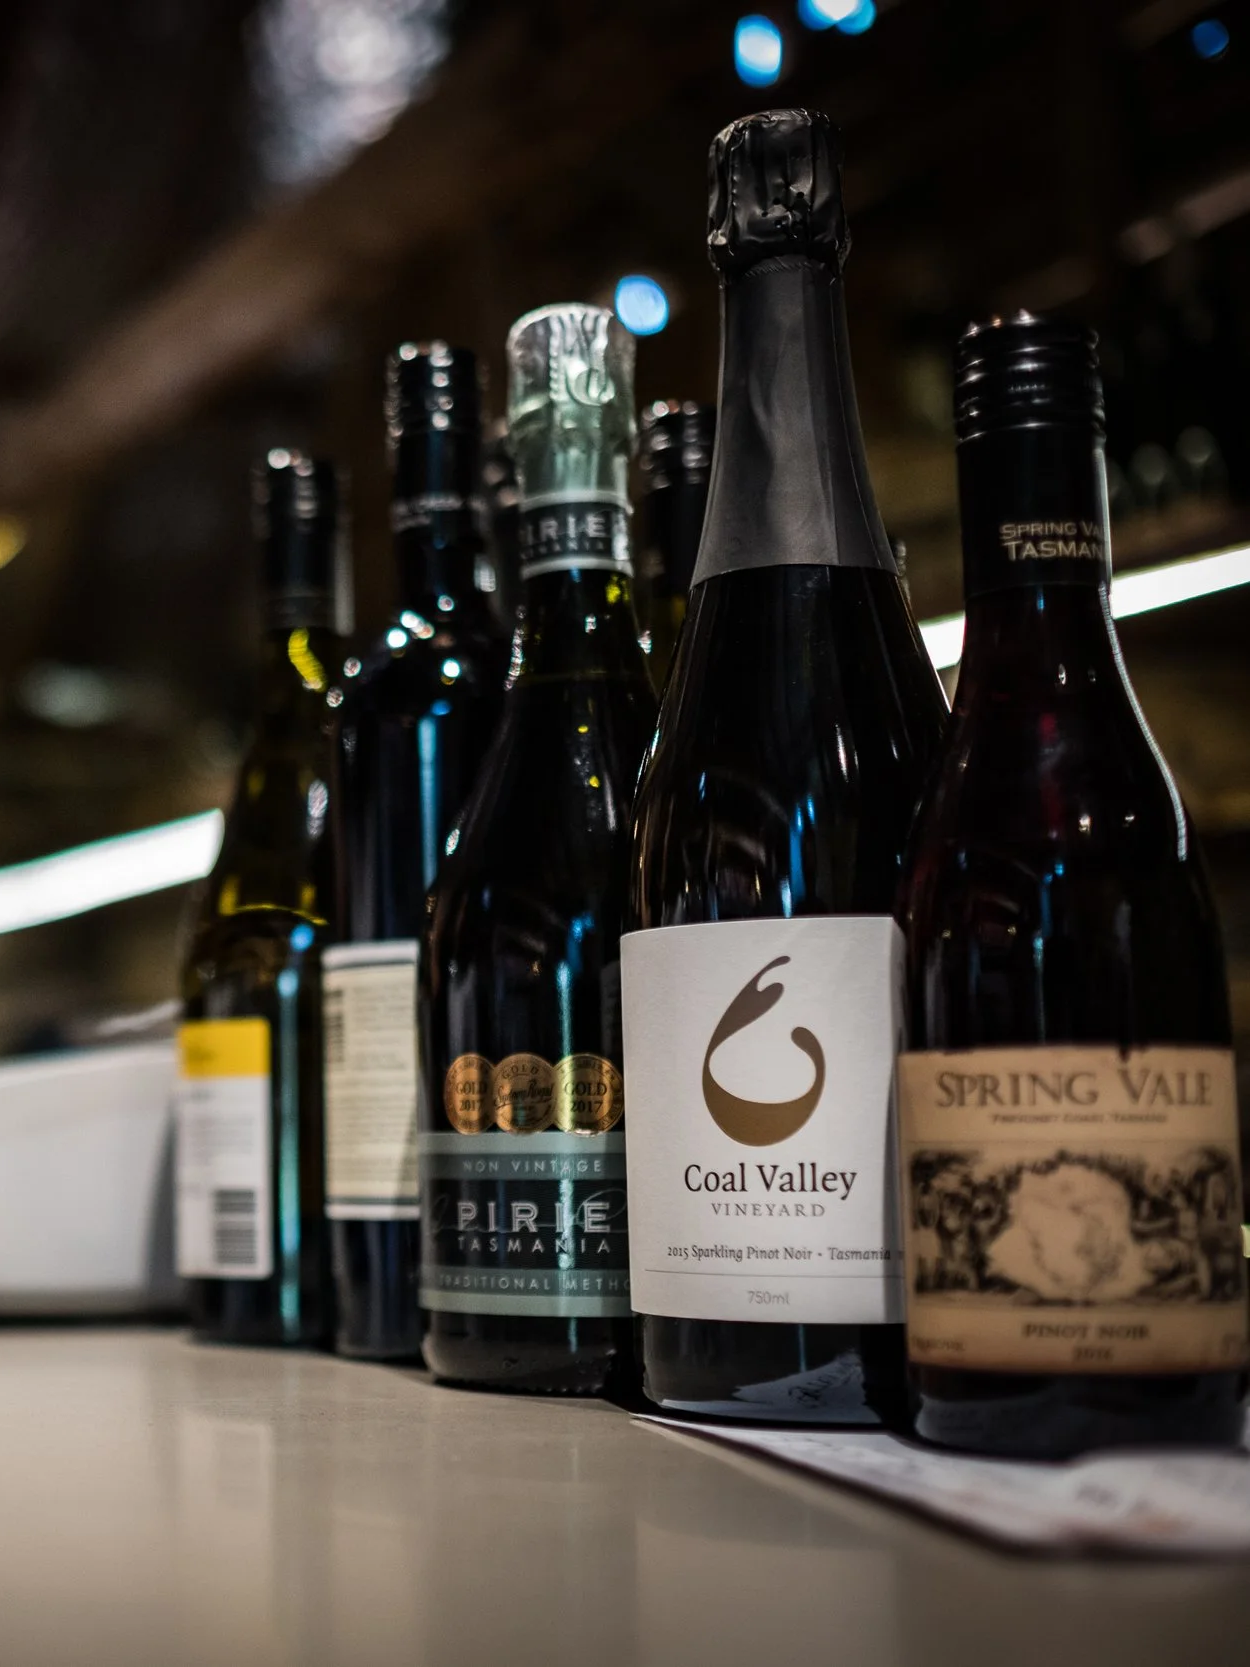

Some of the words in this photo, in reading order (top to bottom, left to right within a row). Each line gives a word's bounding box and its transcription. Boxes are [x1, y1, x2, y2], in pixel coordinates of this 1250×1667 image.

[524, 513, 607, 544] IRIE
[1000, 522, 1078, 539] SPRING
[1080, 521, 1105, 538] VA
[502, 1063, 539, 1080] GOLD
[455, 1082, 488, 1095] GOLD
[564, 1082, 607, 1096] GOLD
[936, 1071, 1099, 1108] SPRING
[1116, 1068, 1212, 1106] VALE
[570, 1101, 602, 1113] 2017
[462, 1160, 499, 1173] NON
[511, 1160, 602, 1173] VINTAGE
[684, 1162, 748, 1192] Coal
[756, 1162, 858, 1200] Valley
[457, 1202, 611, 1232] PIRIE
[710, 1202, 825, 1217] VINEYARD
[458, 1238, 611, 1253] TASMANIA
[667, 1246, 689, 1259] 2015
[691, 1245, 743, 1262] Sparkling
[746, 1246, 779, 1260] Pinot
[784, 1247, 813, 1260] Noir
[826, 1246, 891, 1261] Tasmania
[440, 1275, 550, 1290] TRADITIONAL
[746, 1290, 790, 1305] 750ml
[1023, 1323, 1089, 1339] PINOT
